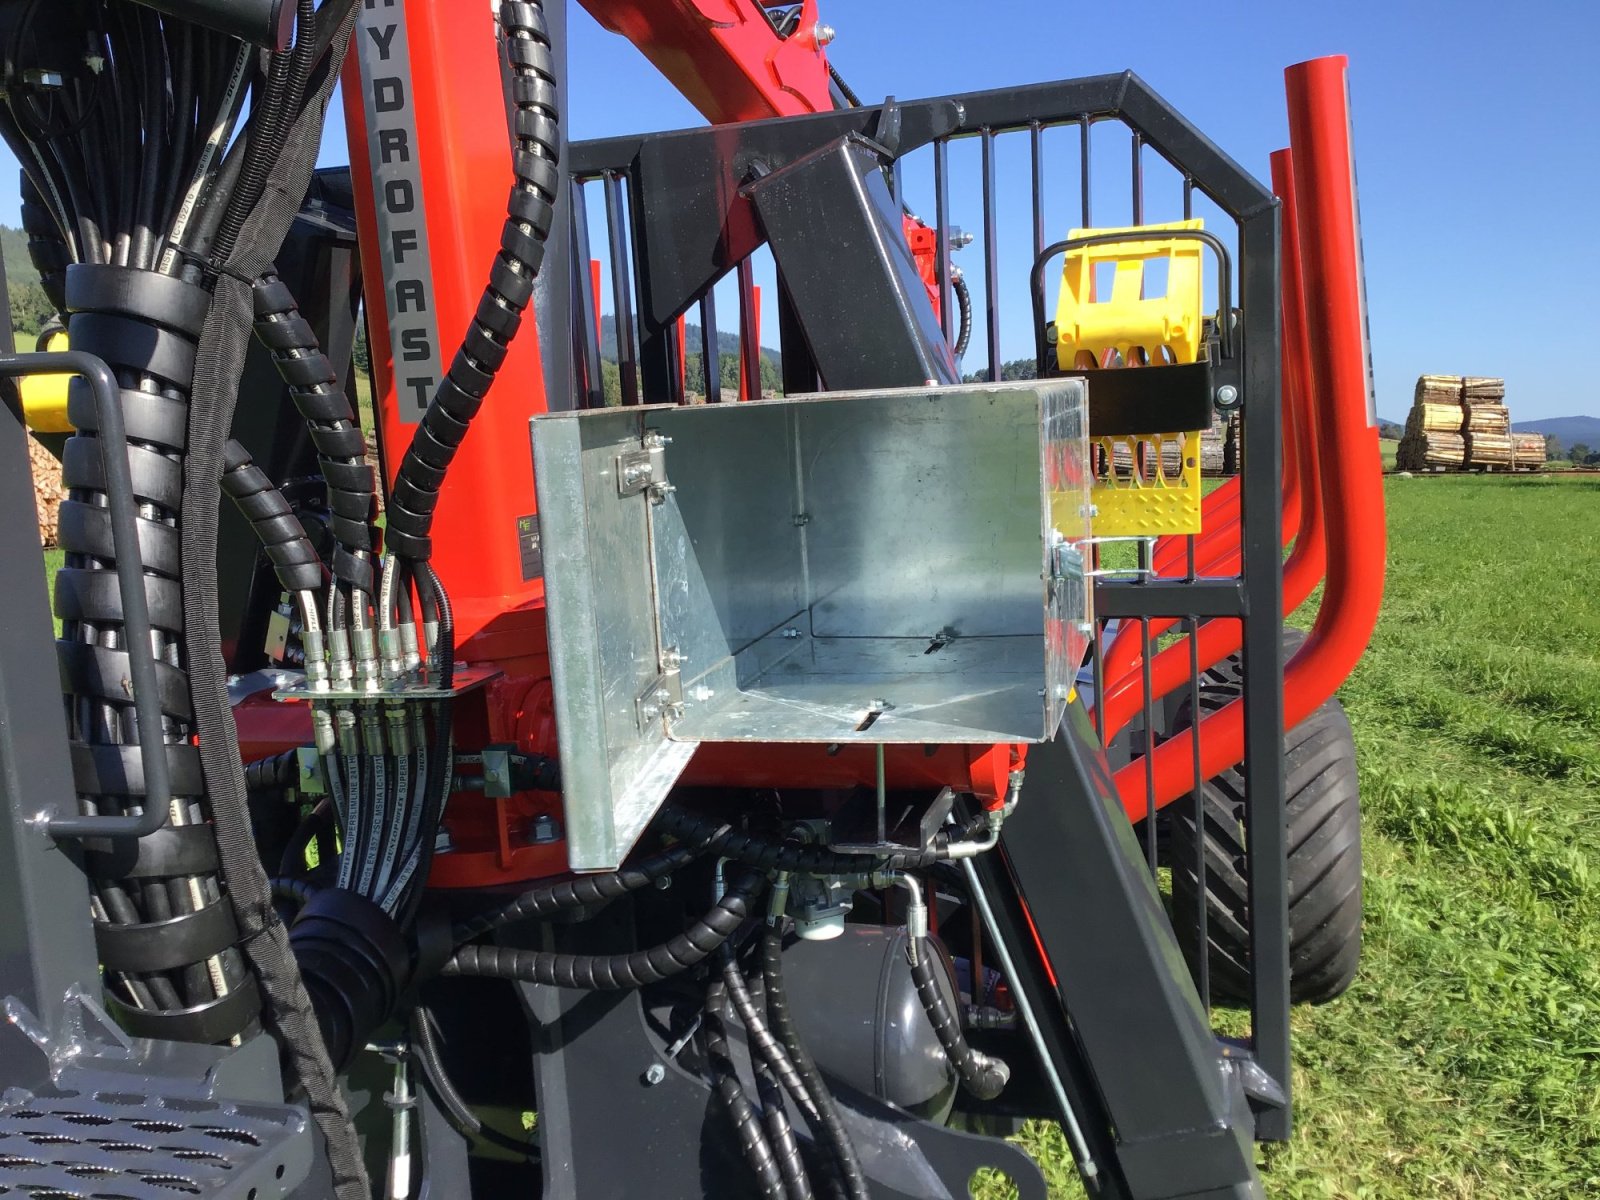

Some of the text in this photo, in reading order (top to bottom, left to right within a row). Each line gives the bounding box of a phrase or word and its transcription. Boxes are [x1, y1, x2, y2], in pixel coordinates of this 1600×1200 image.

[365, 0, 435, 409] YDROFAST
[348, 782, 359, 848] SUPERSLIMLINE
[375, 793, 383, 817] MSHA
